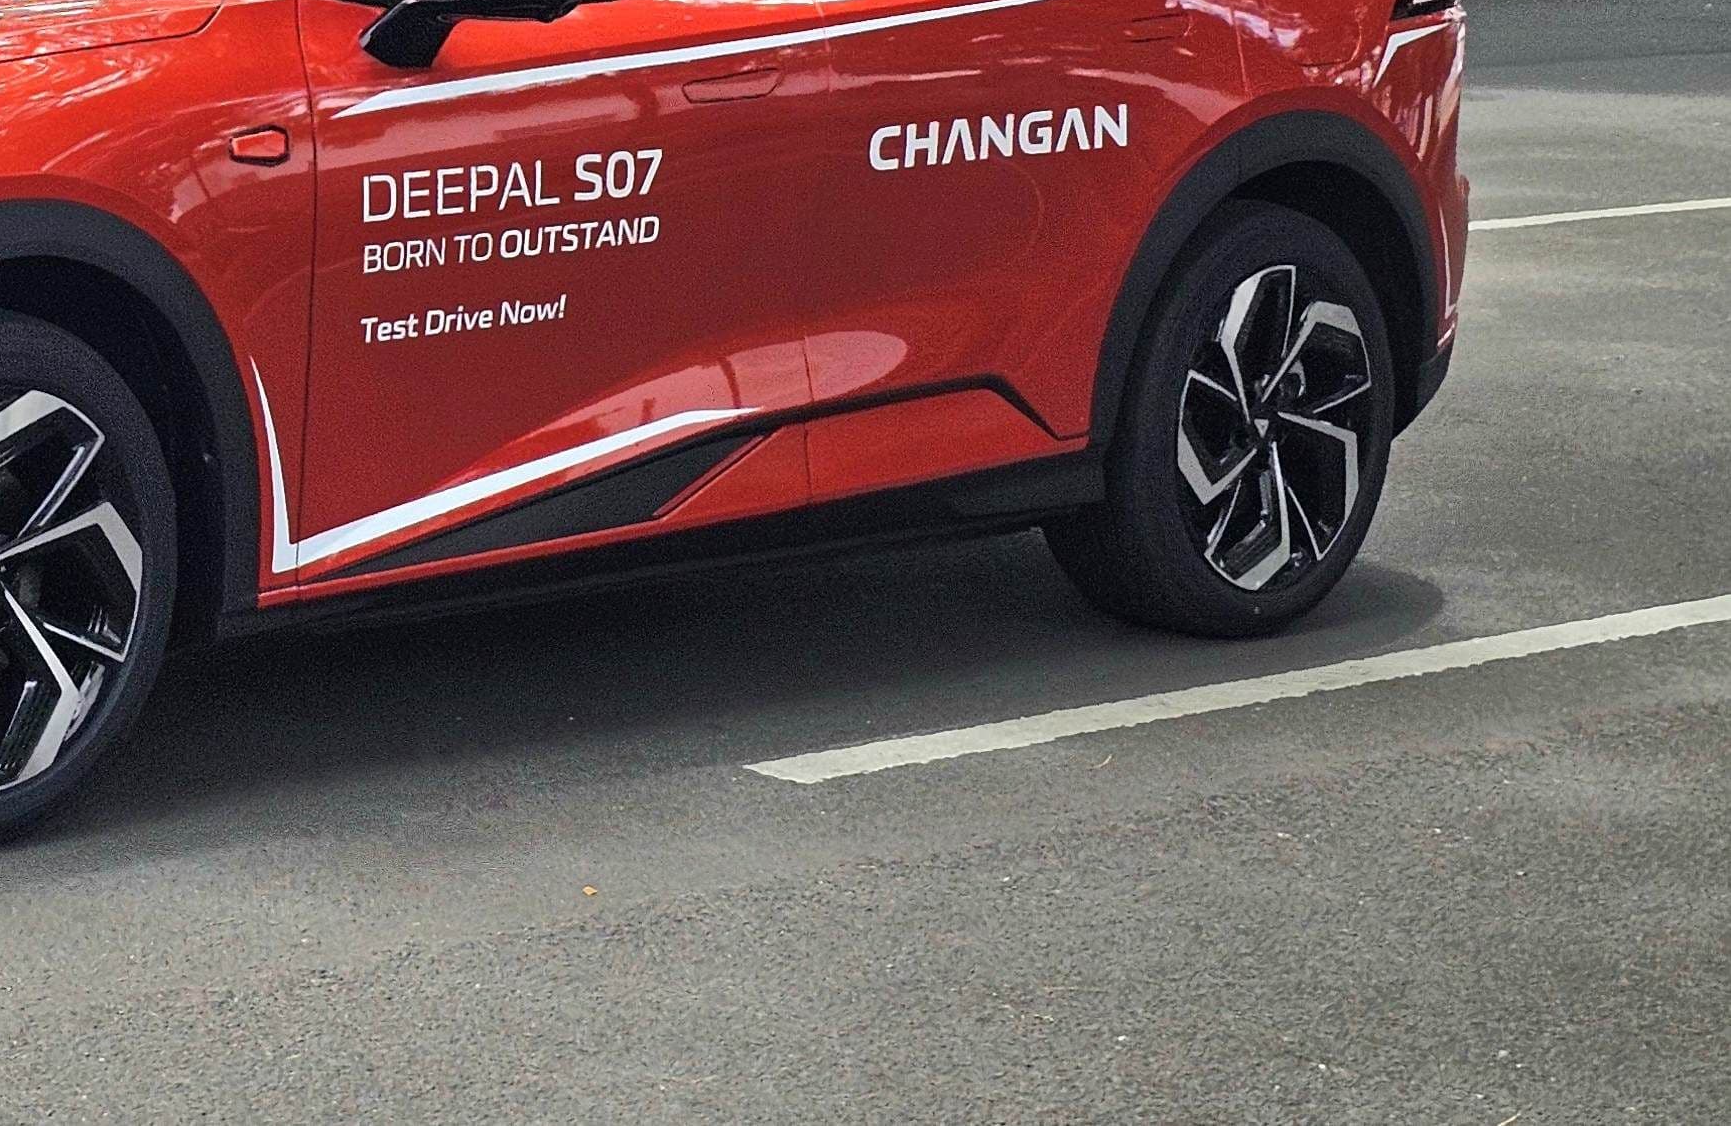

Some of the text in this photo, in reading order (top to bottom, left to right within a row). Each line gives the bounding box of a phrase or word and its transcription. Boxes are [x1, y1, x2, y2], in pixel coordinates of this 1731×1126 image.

[869, 103, 1128, 171] CHANGAN
[362, 149, 663, 223] DEEPAL S07
[363, 215, 660, 274] BORN TO OUTSTAND
[360, 294, 567, 343] Test Drive Now!
